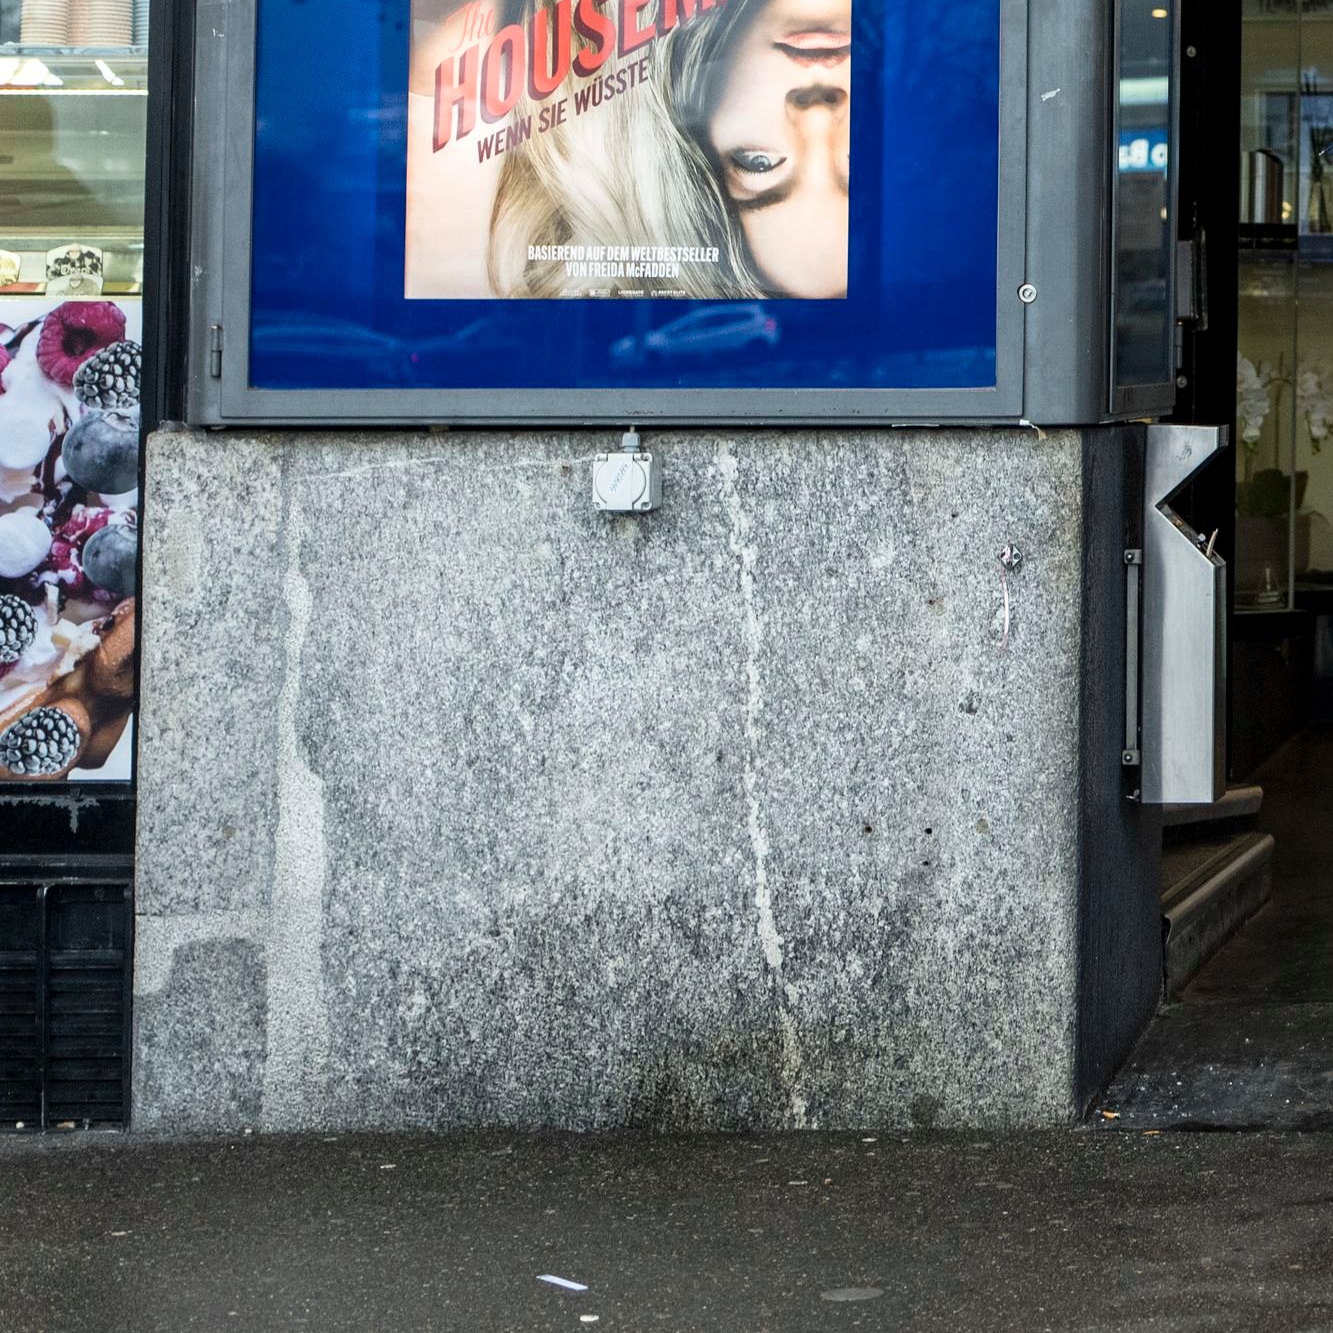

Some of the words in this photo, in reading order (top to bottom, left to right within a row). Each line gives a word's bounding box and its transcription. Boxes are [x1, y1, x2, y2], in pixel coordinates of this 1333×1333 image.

[446, 1, 495, 56] The
[477, 115, 532, 164] WENN
[537, 98, 568, 134] SIE
[573, 57, 650, 116] WÜSSTE
[528, 245, 584, 261] BASIEREND
[586, 246, 605, 261] AUF
[607, 246, 629, 261] DEM
[631, 246, 720, 263] WELTBESTSELLER
[565, 262, 589, 278] VON
[591, 262, 625, 278] FREIDA
[626, 262, 679, 278] McFADDEN
